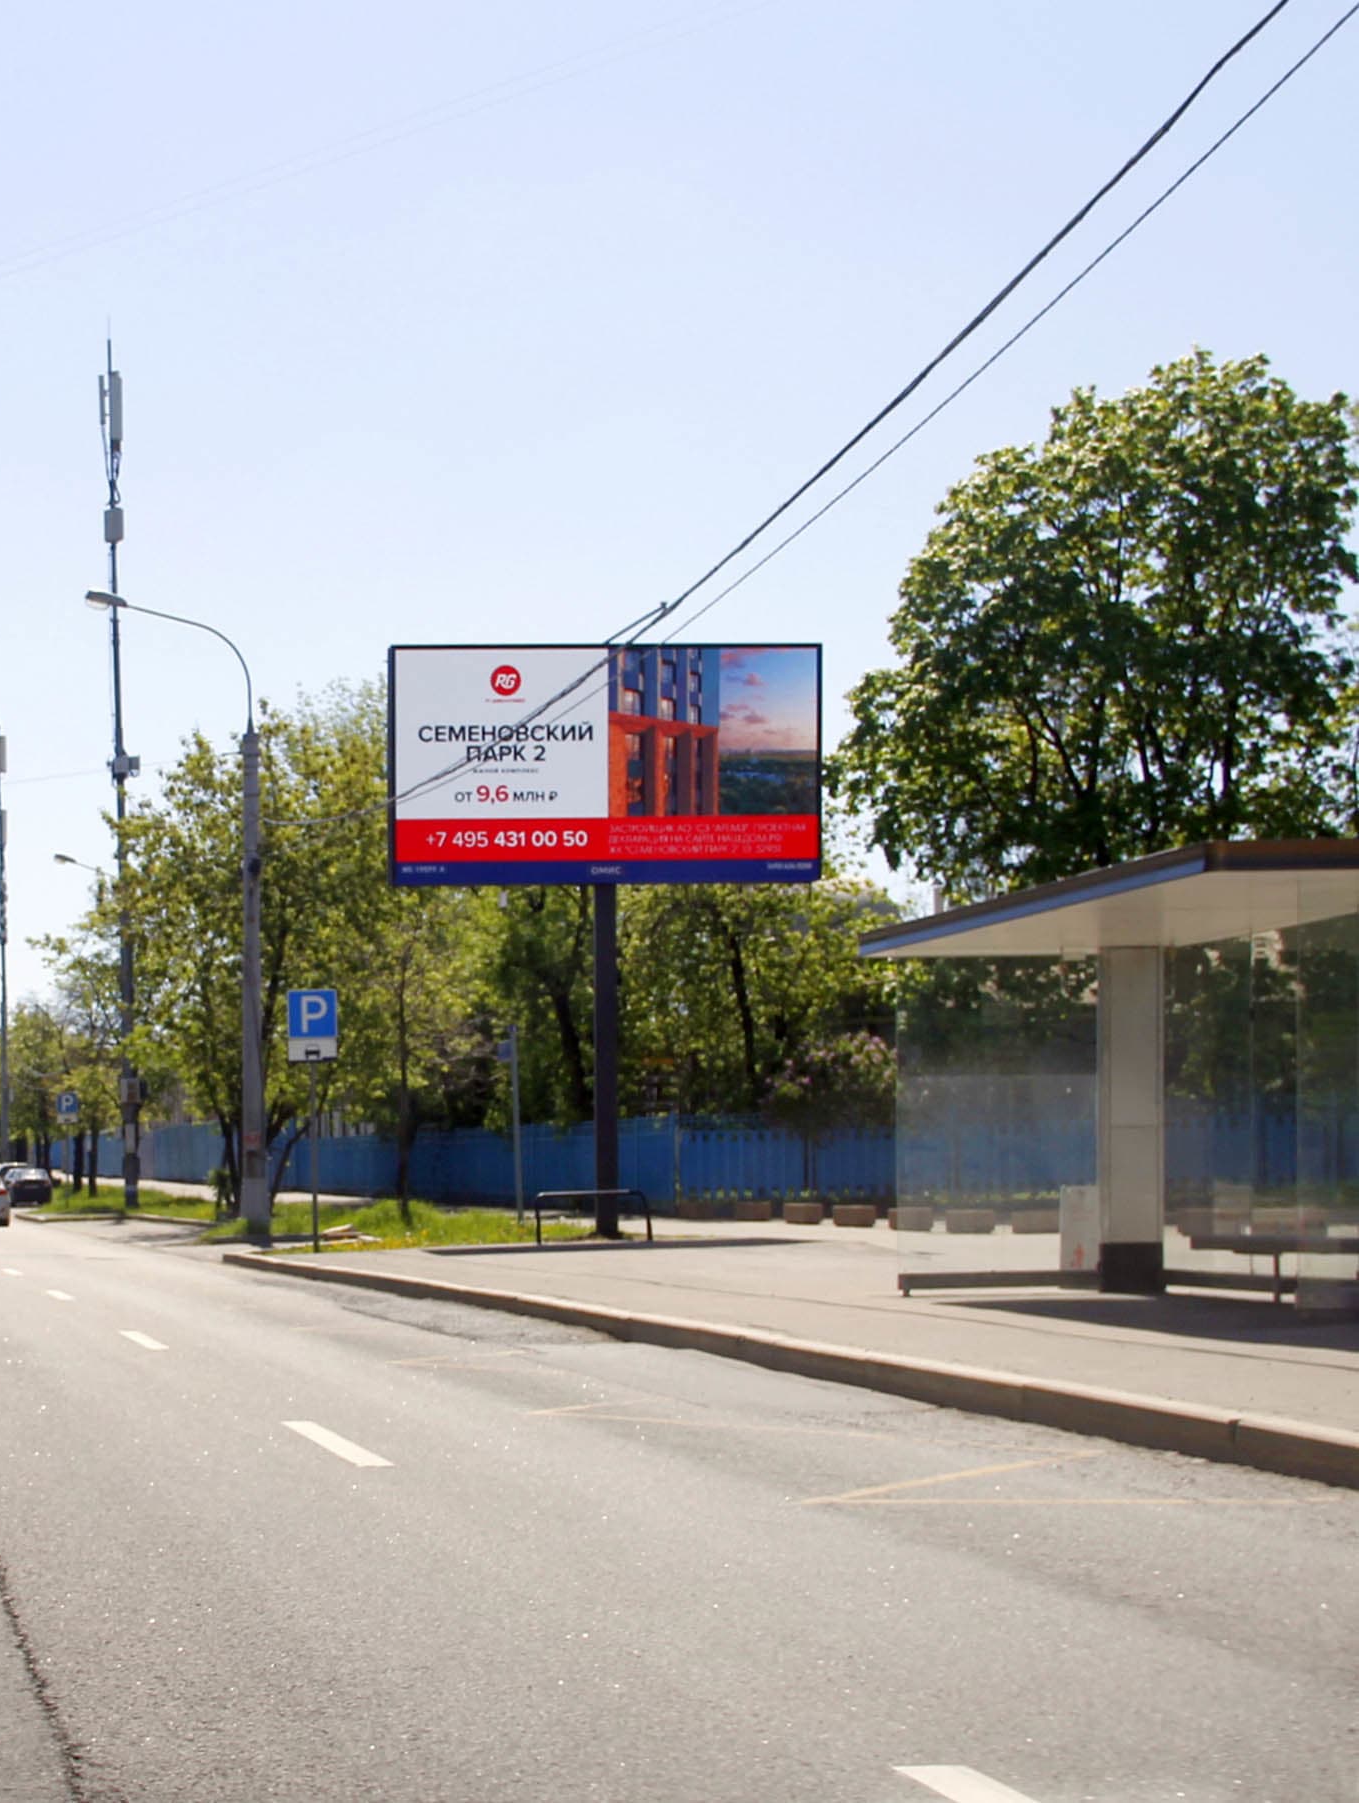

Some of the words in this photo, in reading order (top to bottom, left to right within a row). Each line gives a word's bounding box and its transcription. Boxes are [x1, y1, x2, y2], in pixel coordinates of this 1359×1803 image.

[495, 673, 517, 690] RG
[418, 721, 594, 743] СЕМЕНОВСКИЙ
[466, 745, 526, 762] ПАРК
[534, 745, 546, 762] 2
[476, 785, 509, 805] 9,6
[426, 831, 447, 847] +7
[452, 831, 489, 848] 495
[494, 830, 526, 847] 431
[531, 830, 557, 847] 00
[563, 830, 589, 847] 50
[301, 995, 328, 1034] P
[61, 1094, 74, 1112] P
